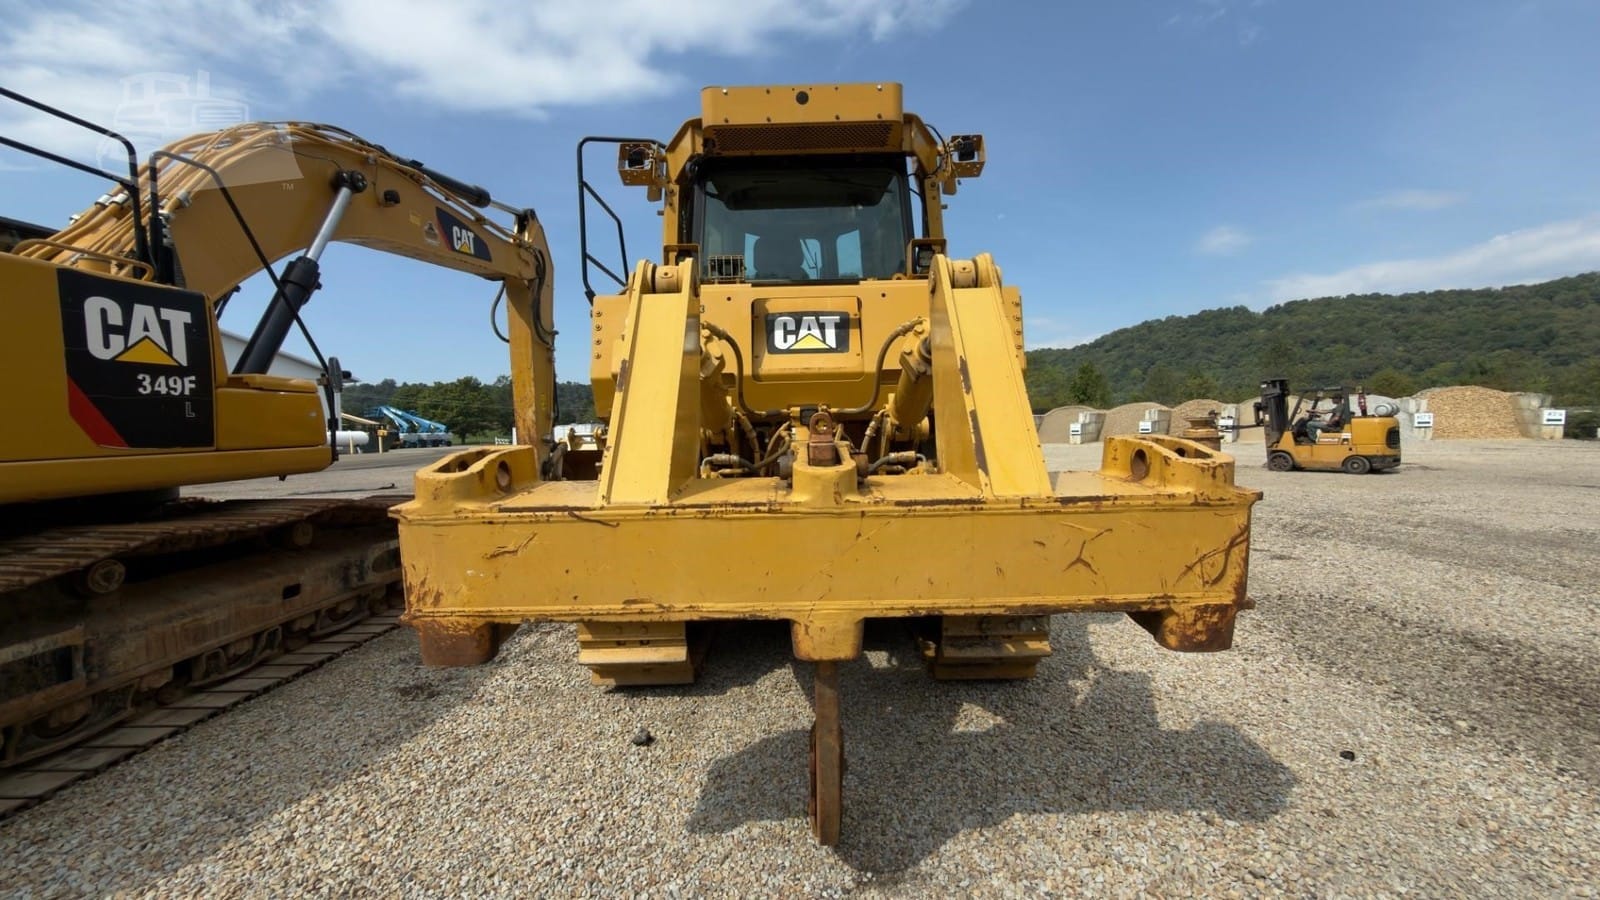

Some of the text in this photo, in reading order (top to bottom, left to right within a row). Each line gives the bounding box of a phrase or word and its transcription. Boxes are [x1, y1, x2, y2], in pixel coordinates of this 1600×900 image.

[452, 225, 474, 255] CAT
[84, 296, 192, 367] CAT
[774, 316, 840, 350] CAT
[137, 373, 196, 396] 349F
[185, 401, 195, 417] L
